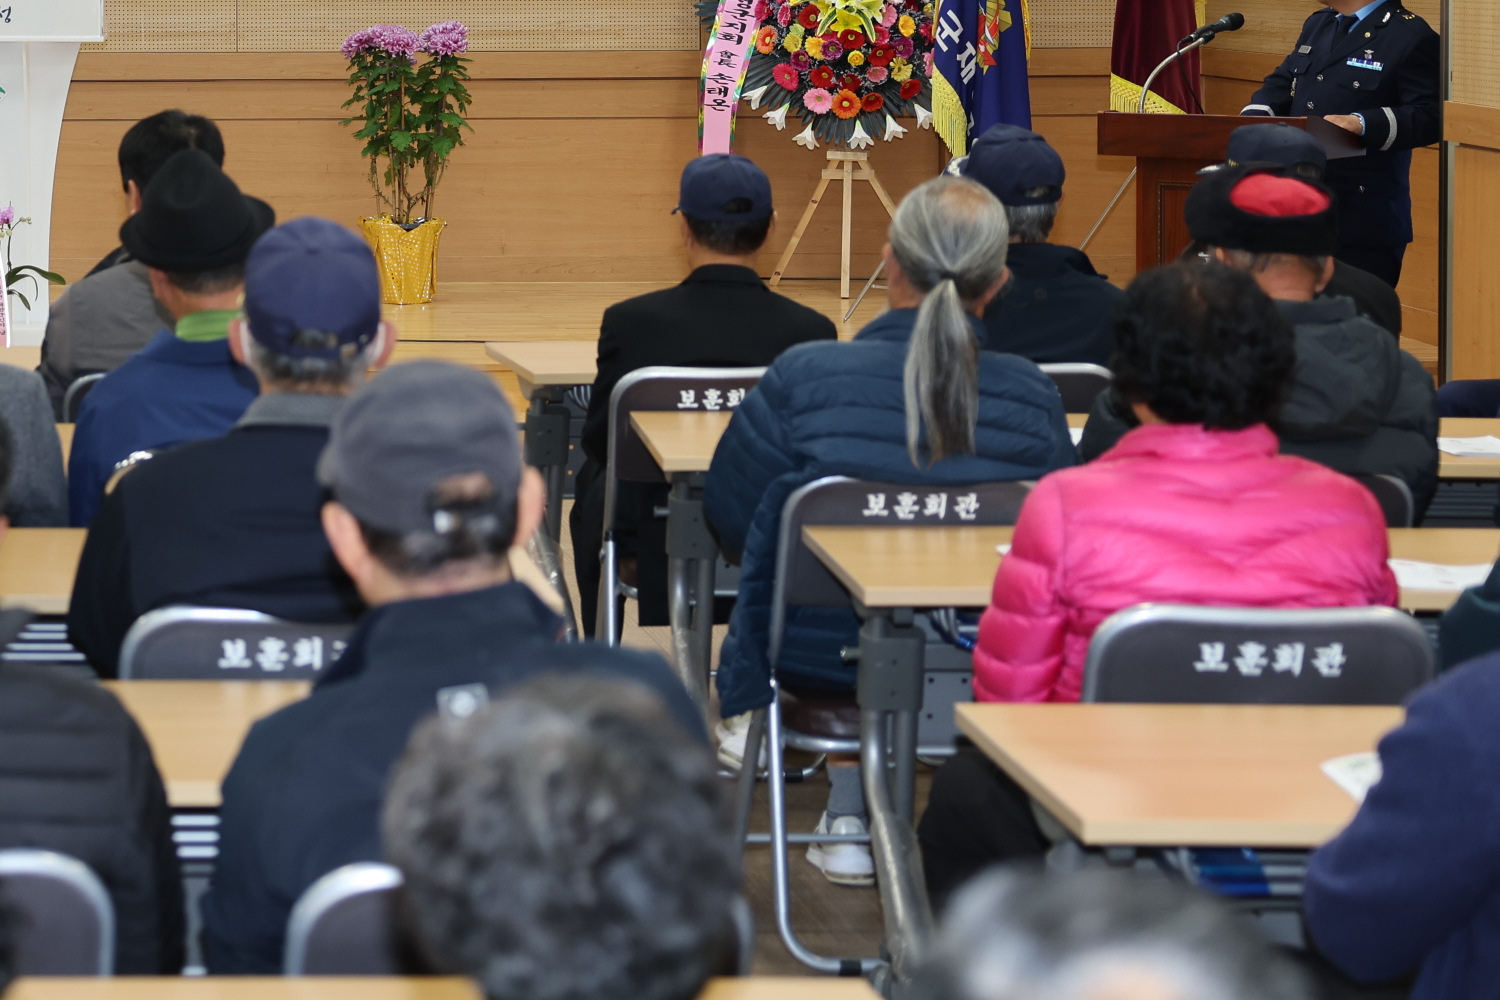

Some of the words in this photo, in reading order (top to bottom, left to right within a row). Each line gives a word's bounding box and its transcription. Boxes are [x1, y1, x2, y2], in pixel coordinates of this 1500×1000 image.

[677, 388, 746, 411] 보훈회
[862, 491, 980, 520] 보훈회관
[217, 636, 347, 672] 보훈회
[1192, 641, 1347, 678] 보훈회관
